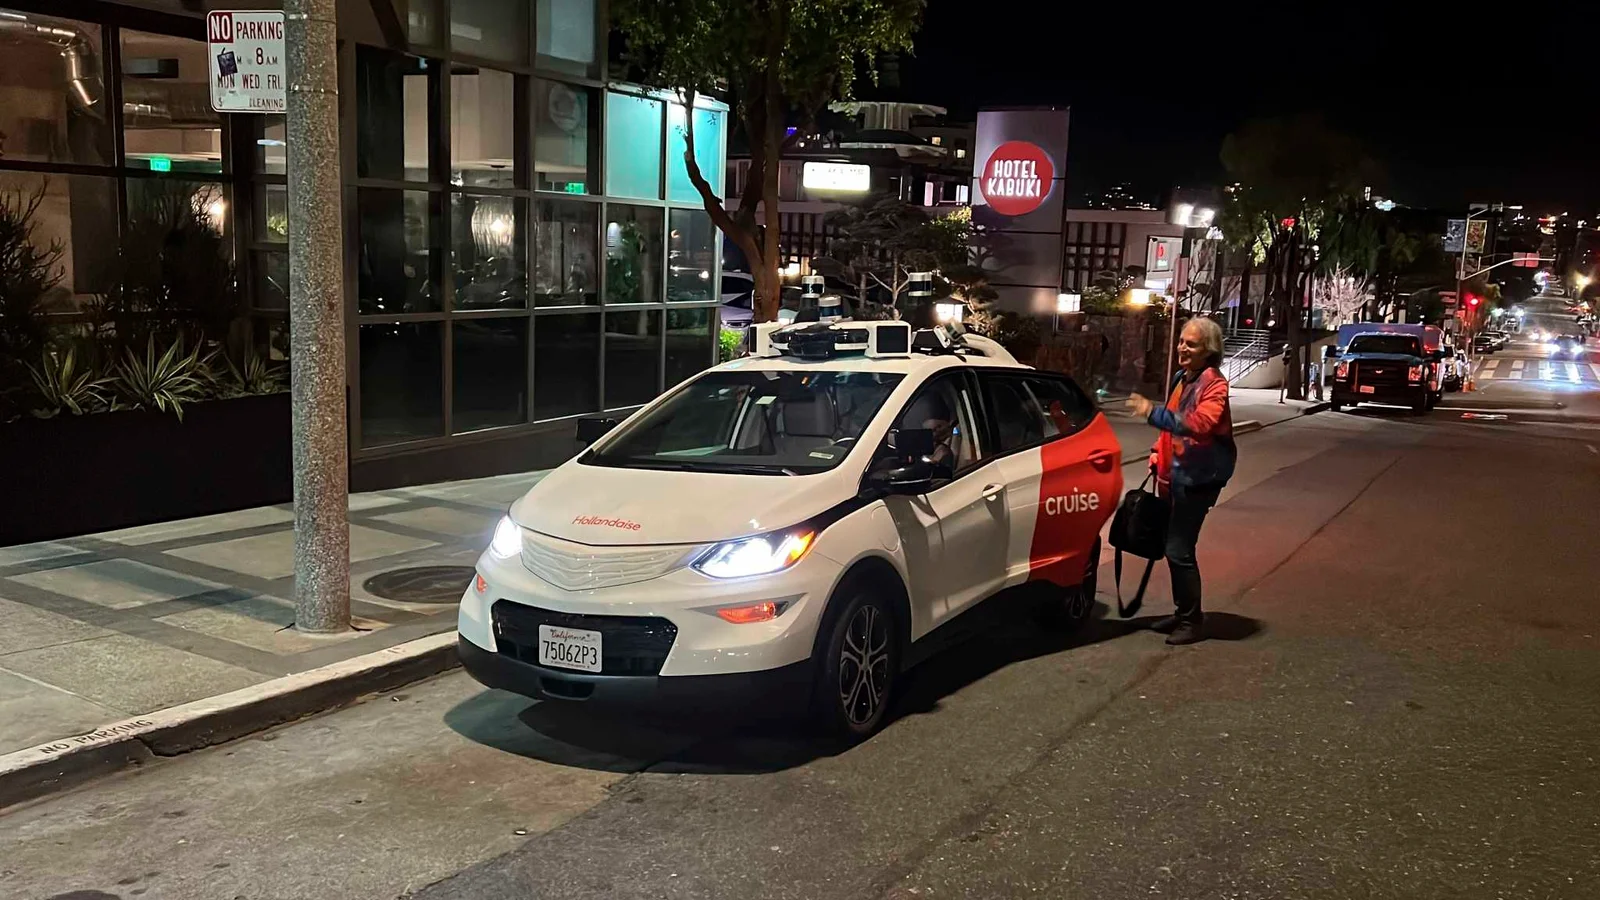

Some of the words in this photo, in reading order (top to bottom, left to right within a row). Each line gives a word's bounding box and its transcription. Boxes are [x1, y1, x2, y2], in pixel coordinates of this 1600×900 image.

[210, 14, 231, 40] NO
[236, 21, 283, 40] PARKING
[255, 47, 264, 65] 8
[994, 159, 1038, 179] HOTEL
[987, 177, 1042, 198] KABUKI
[1045, 486, 1100, 516] cruise
[571, 514, 642, 531] Hollandaise
[542, 639, 598, 666] 75062P3
[39, 742, 71, 755] NO
[73, 719, 154, 744] PARKING
